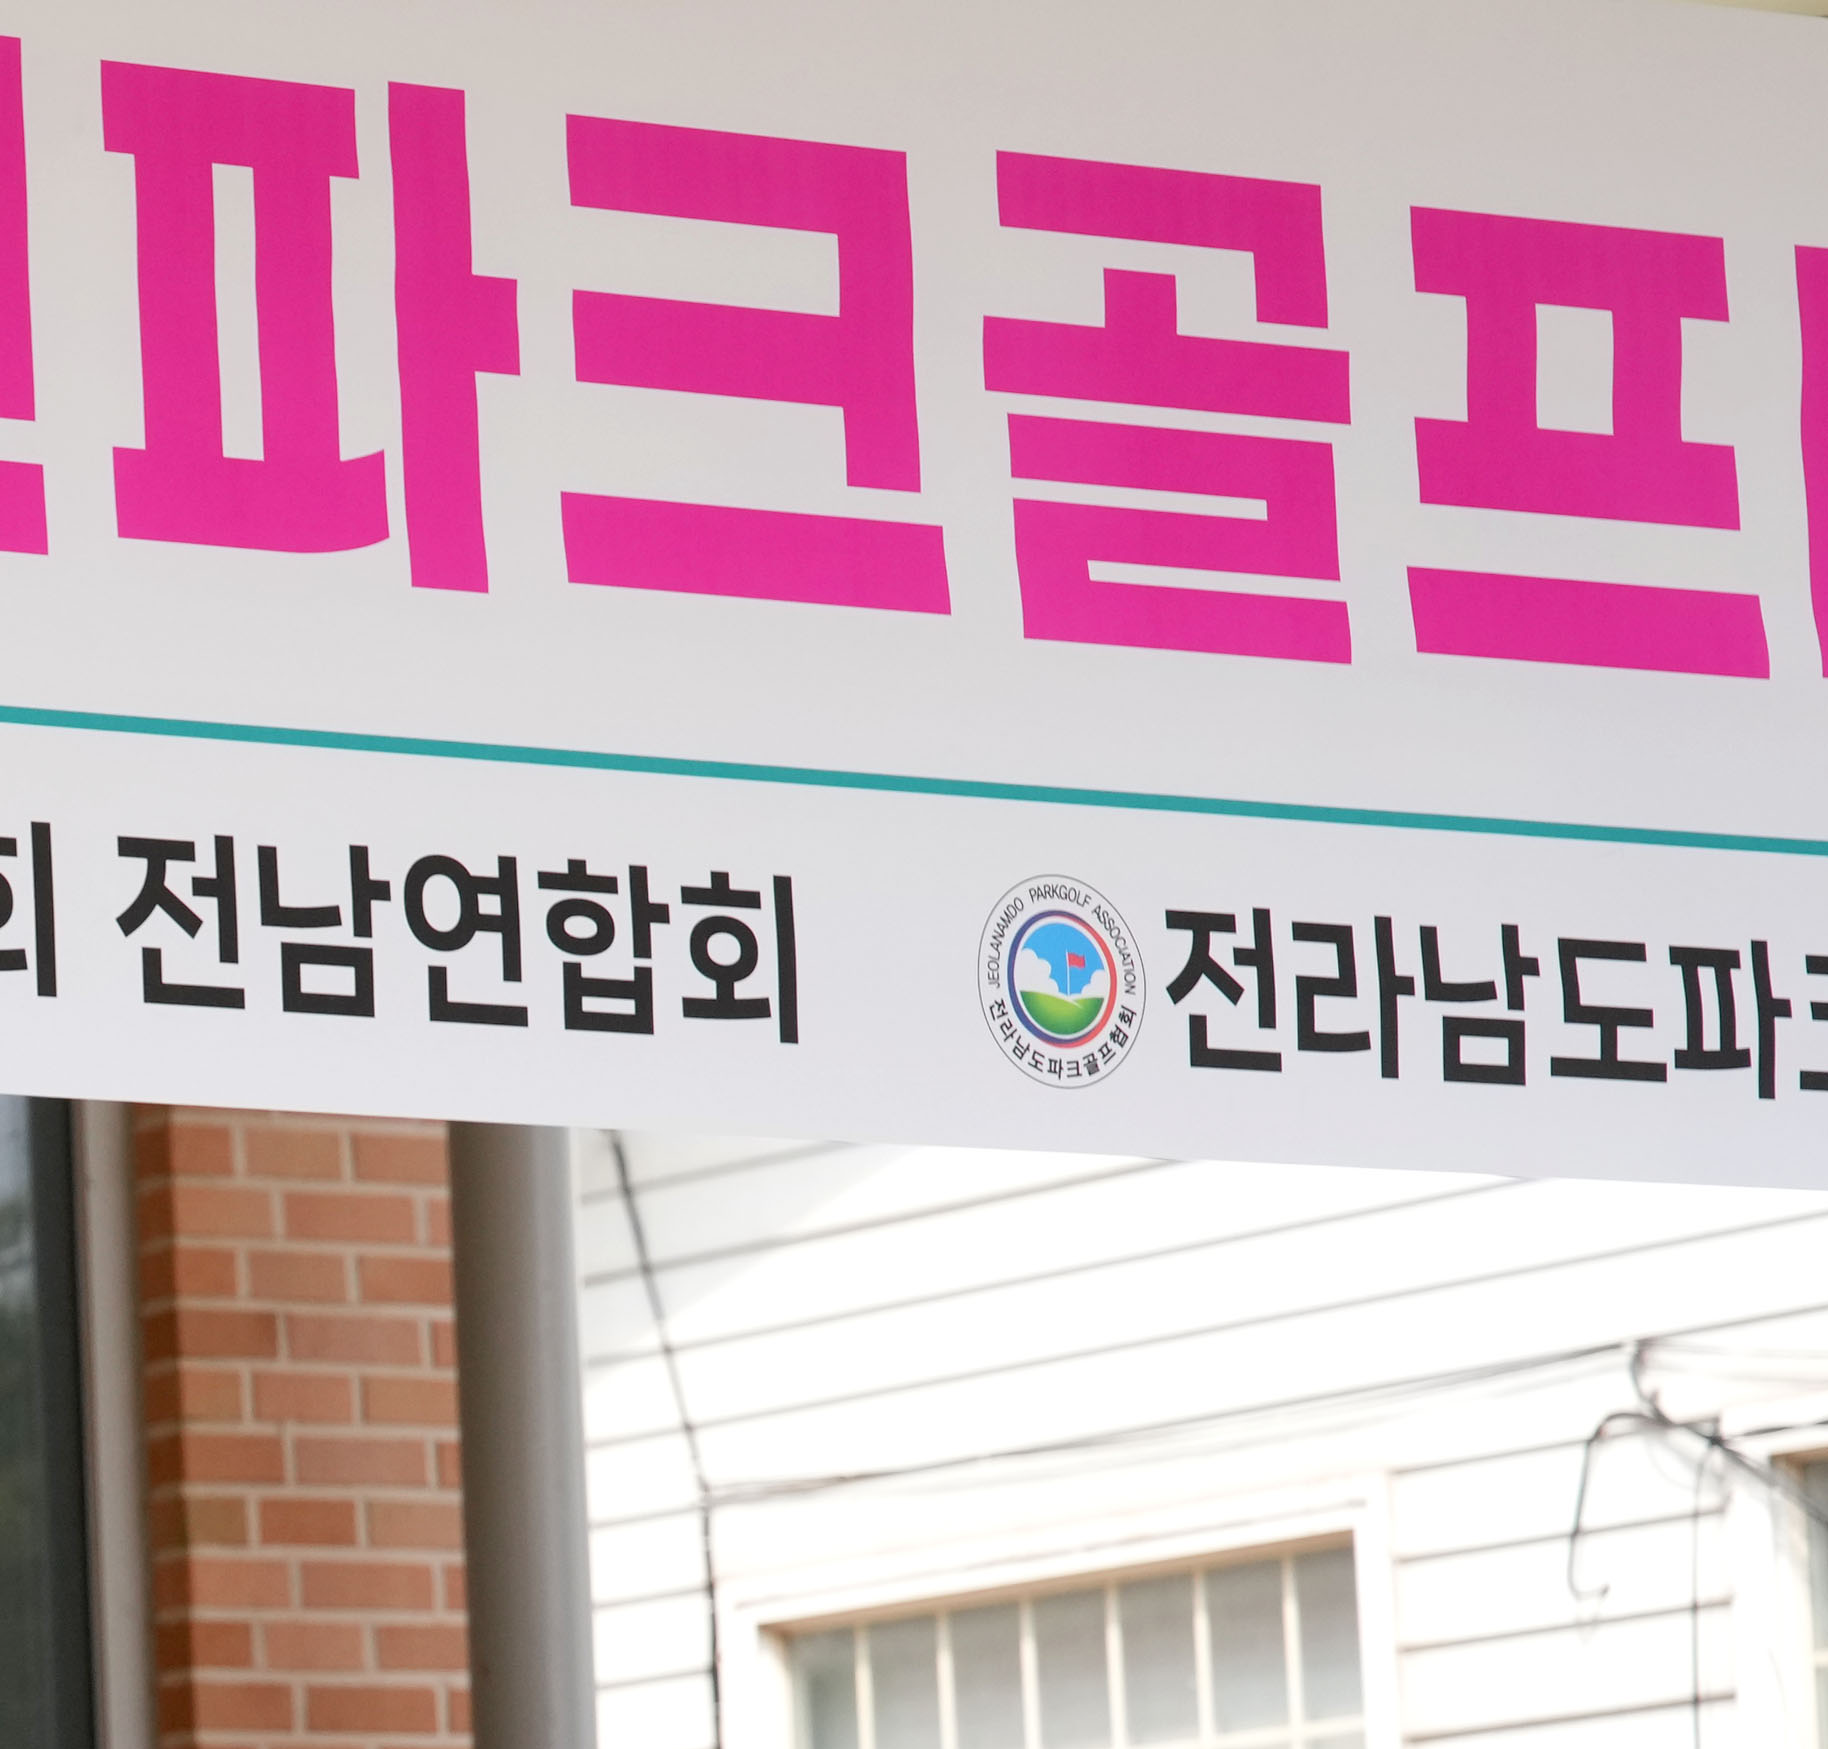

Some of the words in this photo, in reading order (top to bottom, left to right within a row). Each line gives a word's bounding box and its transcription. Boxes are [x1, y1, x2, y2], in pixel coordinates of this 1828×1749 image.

[116, 834, 800, 1044] 전남연합회
[1028, 883, 1092, 908] PARKGOLF
[1091, 904, 1137, 996] ASSOCIATION
[1164, 906, 1828, 1100] 전라남도파
[989, 998, 1137, 1081] 전라남도파크골프협회
